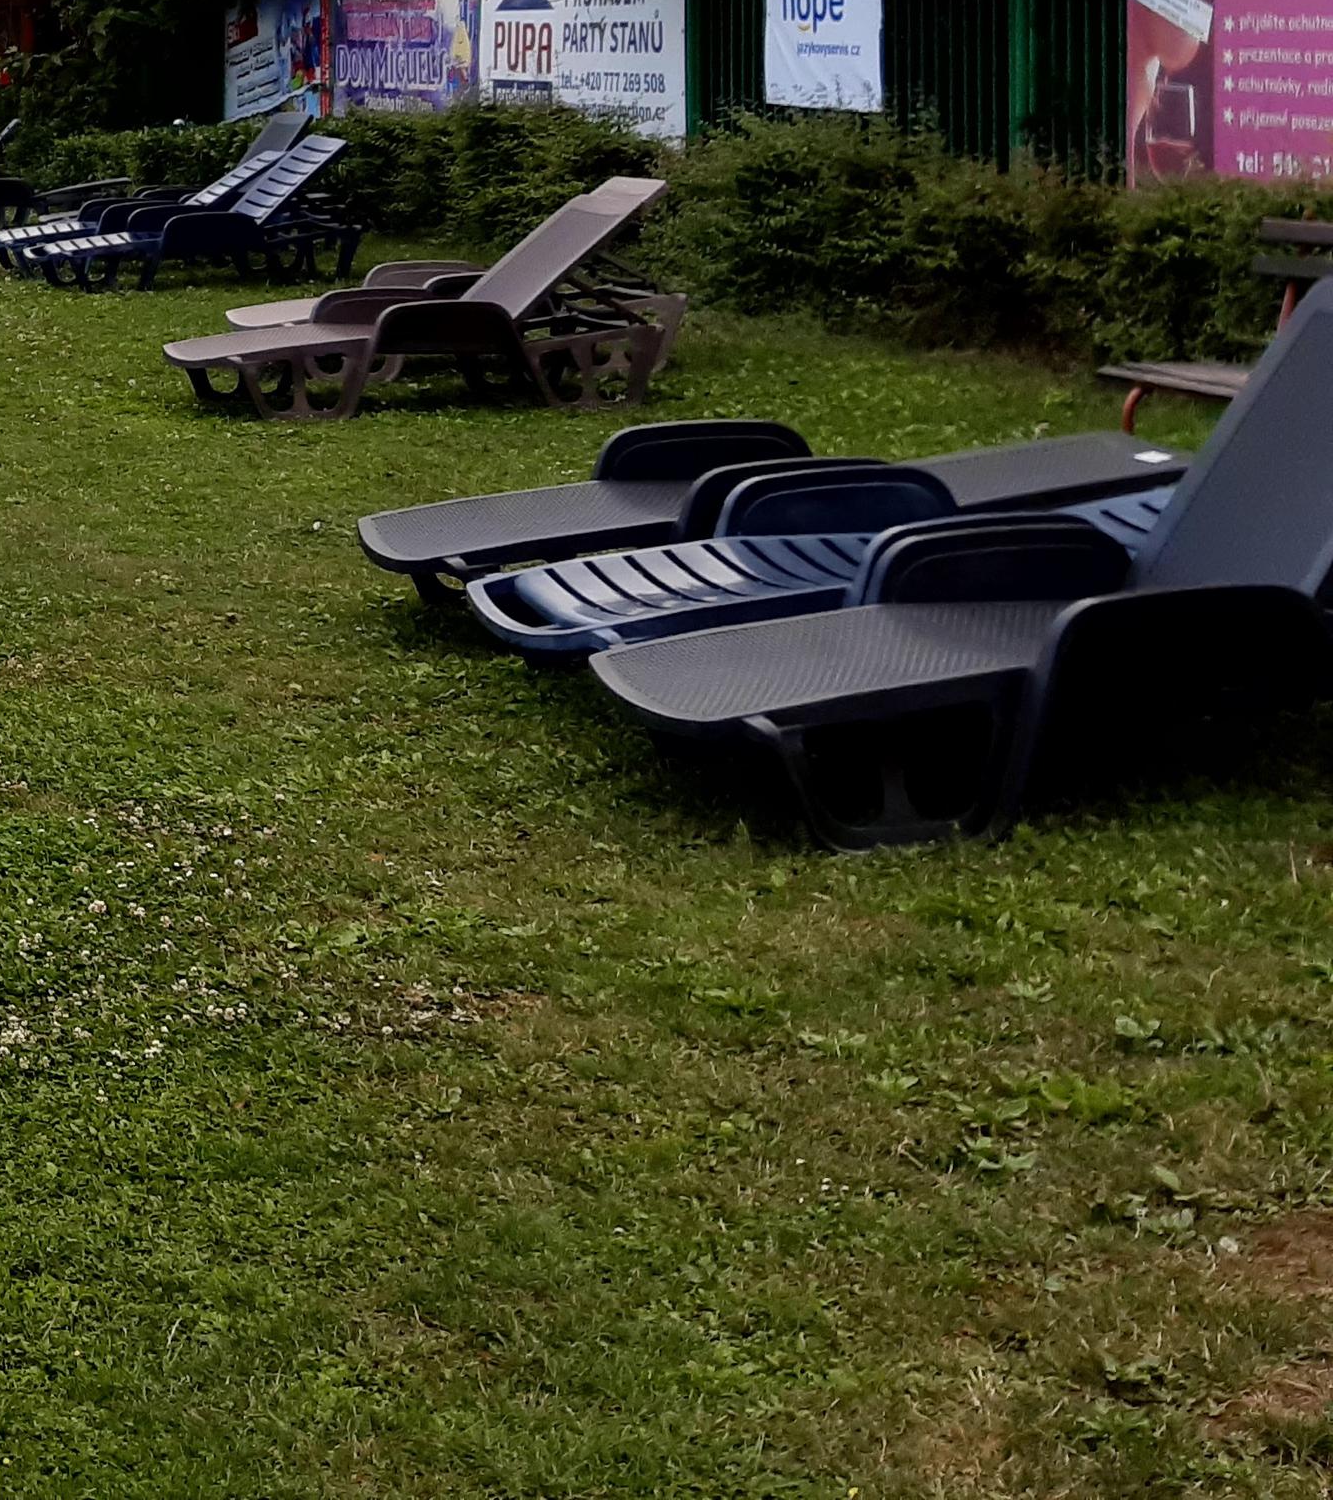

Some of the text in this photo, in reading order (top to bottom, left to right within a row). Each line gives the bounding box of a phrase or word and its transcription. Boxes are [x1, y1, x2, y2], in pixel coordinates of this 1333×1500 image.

[493, 20, 553, 75] PUPA
[610, 9, 663, 54] STANŮ
[603, 72, 620, 92] 777
[623, 72, 641, 92] 269
[644, 72, 665, 93] 508
